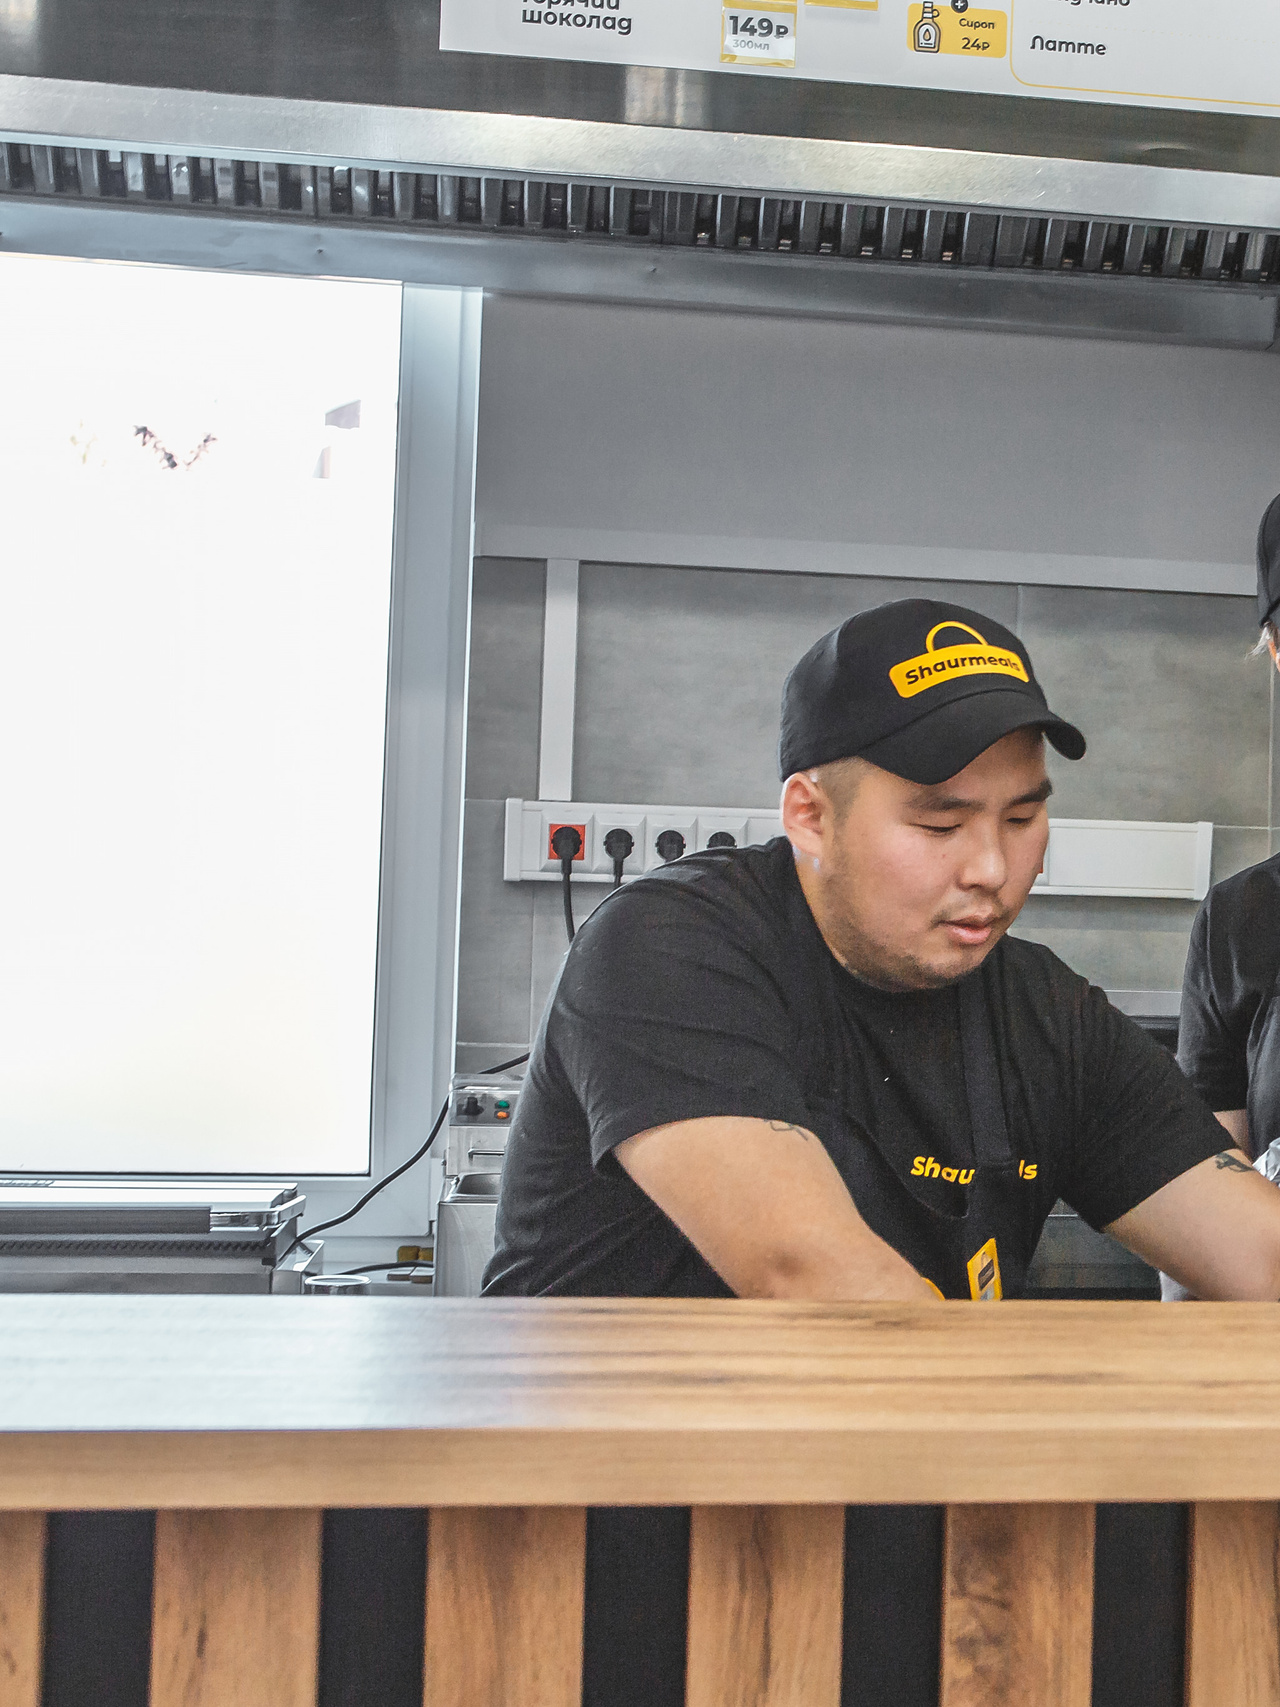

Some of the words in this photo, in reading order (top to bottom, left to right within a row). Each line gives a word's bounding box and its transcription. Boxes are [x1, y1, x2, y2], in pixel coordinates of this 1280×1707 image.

[521, 9, 633, 36] шоколад
[958, 17, 996, 31] Сироп
[1029, 34, 1108, 57] Латте
[905, 655, 1021, 686] Shaurmeals
